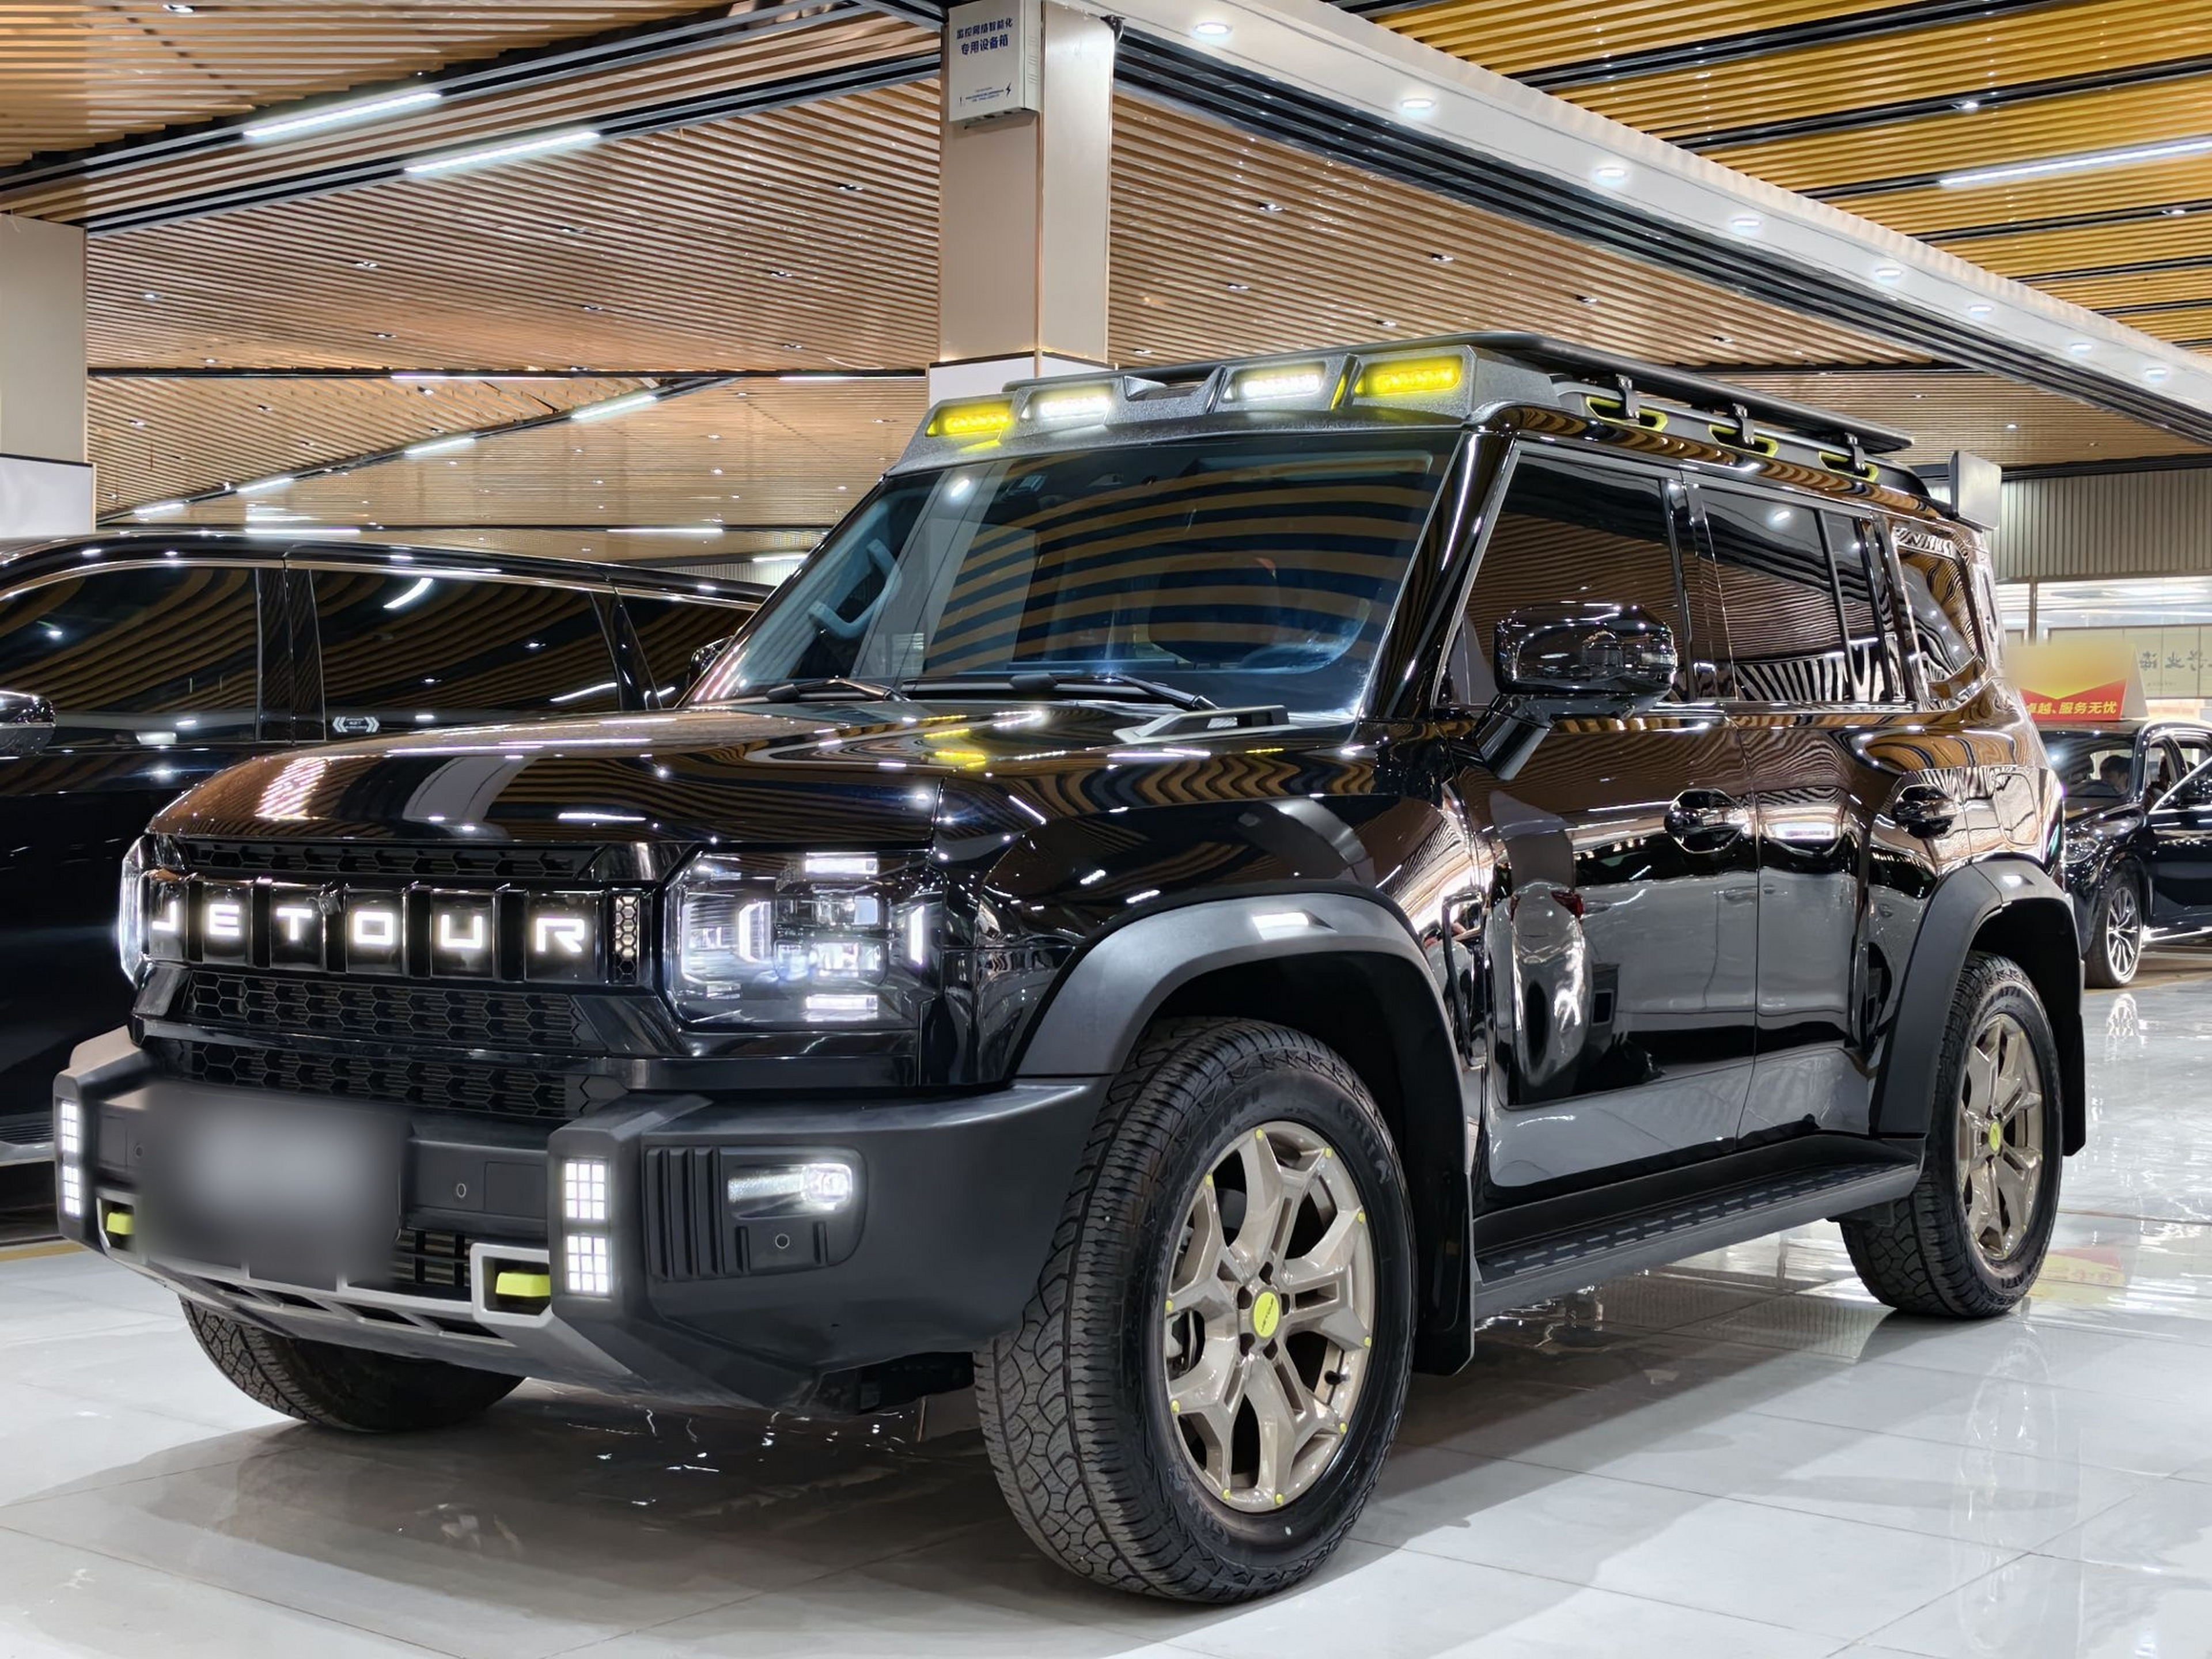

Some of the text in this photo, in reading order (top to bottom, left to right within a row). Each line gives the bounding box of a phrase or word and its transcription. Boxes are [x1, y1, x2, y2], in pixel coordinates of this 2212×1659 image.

[961, 34, 1008, 55] 专用设备箱
[151, 901, 586, 953] JETOUR
